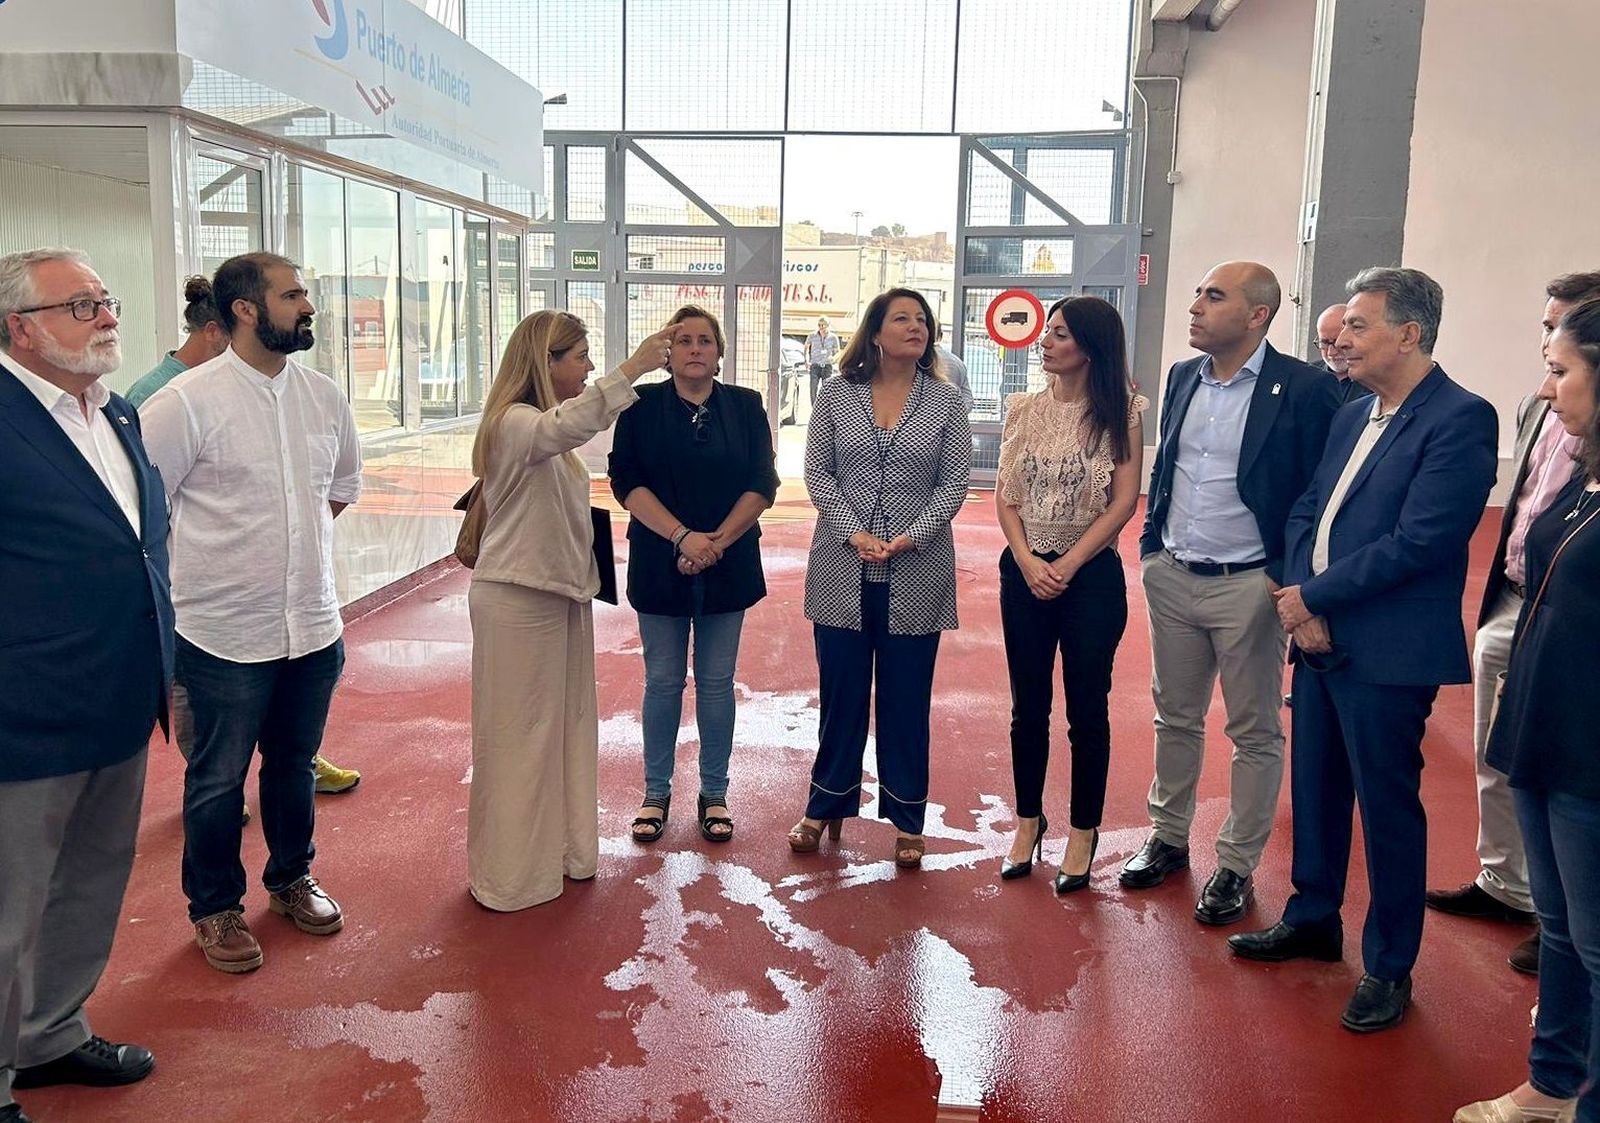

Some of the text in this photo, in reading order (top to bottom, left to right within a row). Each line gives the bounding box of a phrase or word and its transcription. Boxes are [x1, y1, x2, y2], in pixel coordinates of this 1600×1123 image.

[356, 8, 406, 72] Puerto
[409, 43, 426, 82] de
[392, 111, 433, 142] Autoridad
[574, 255, 597, 265] SALIDA
[688, 262, 724, 272] pesca
